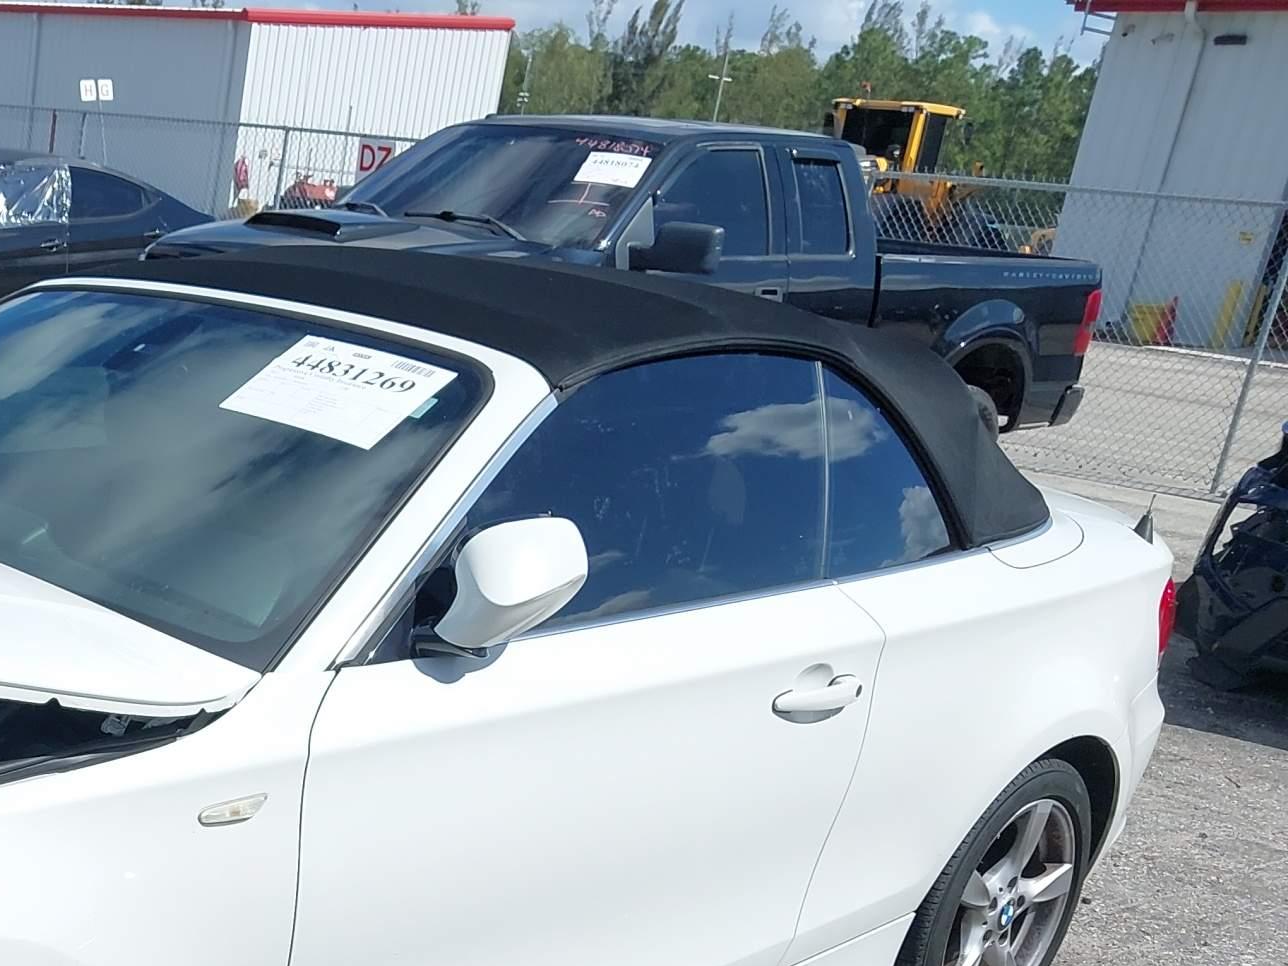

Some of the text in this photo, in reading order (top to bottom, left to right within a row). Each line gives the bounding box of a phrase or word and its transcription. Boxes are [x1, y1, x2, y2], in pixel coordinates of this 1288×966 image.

[84, 84, 93, 97] H
[100, 83, 110, 97] G
[291, 353, 416, 393] 44831269
